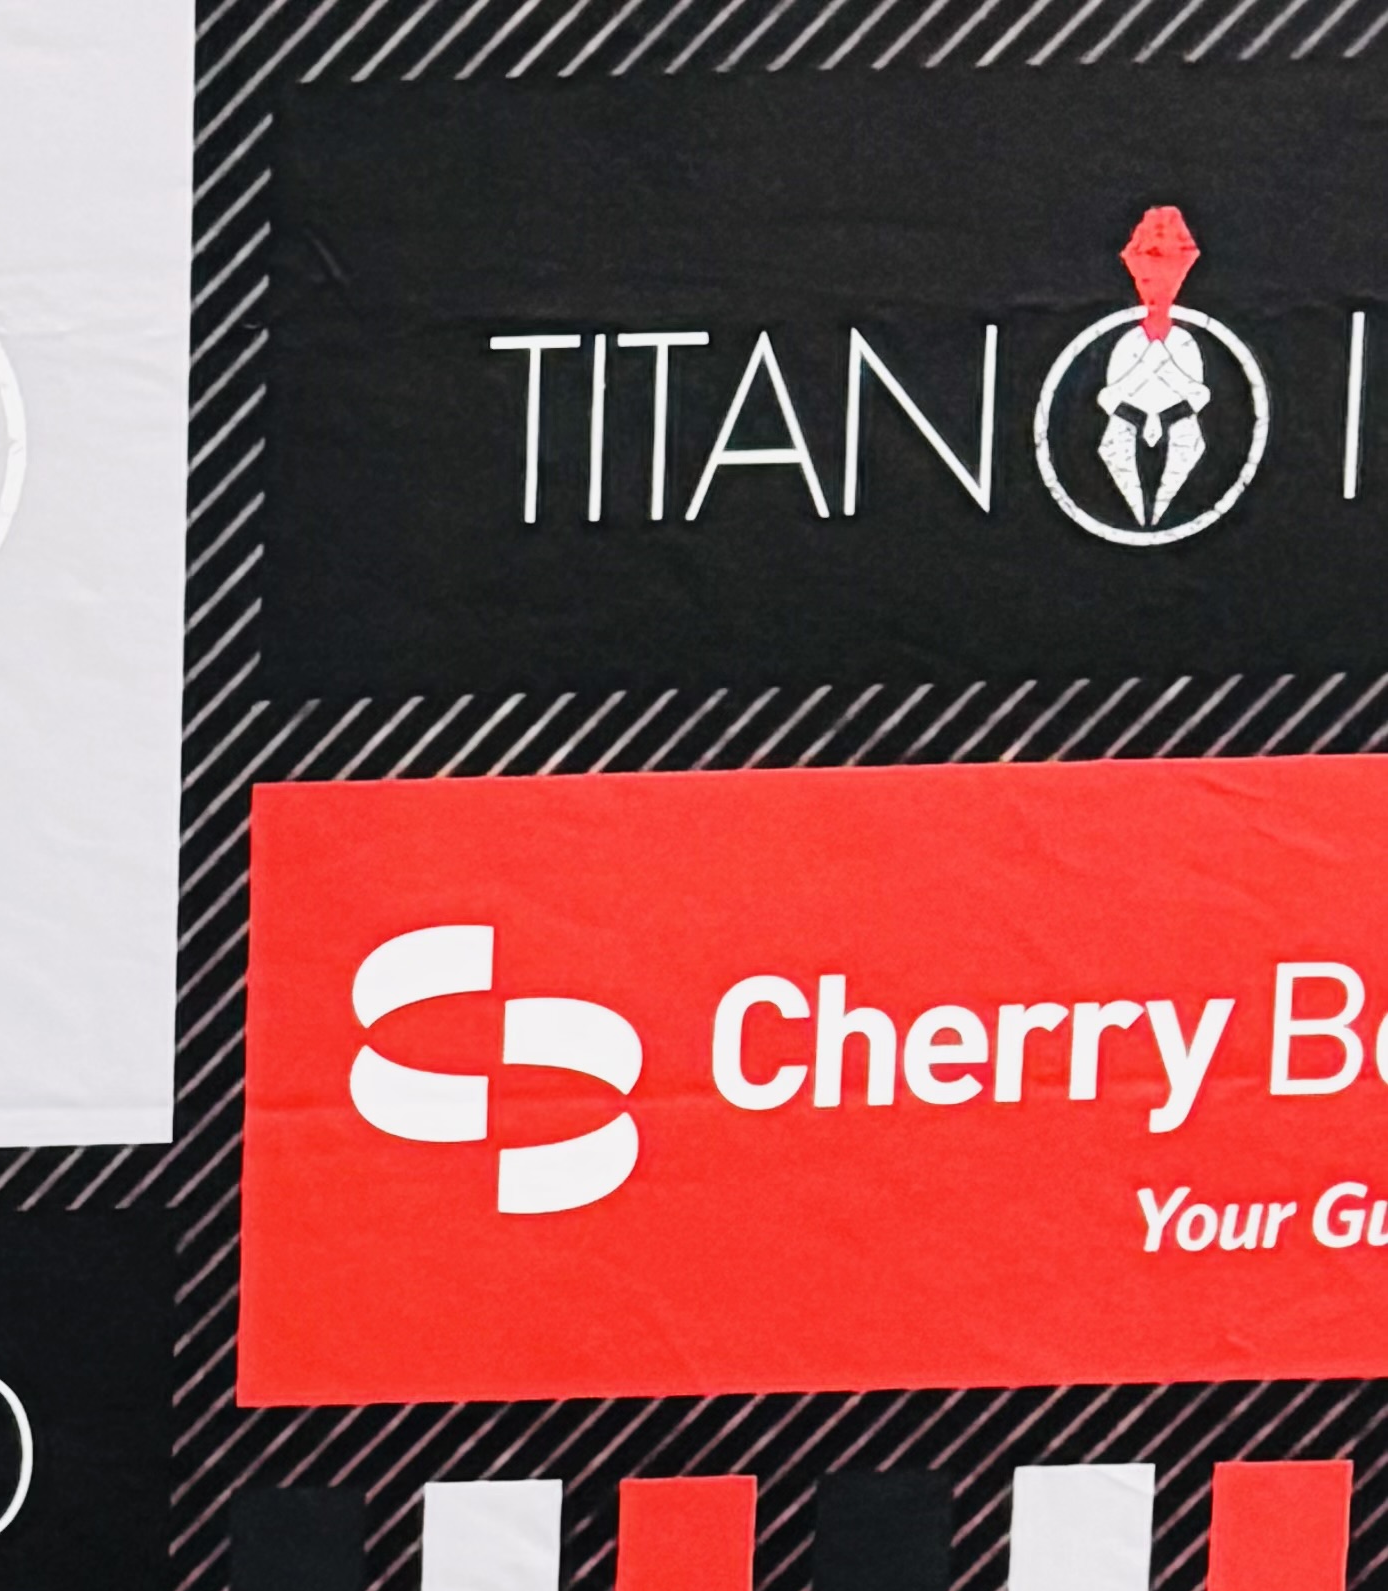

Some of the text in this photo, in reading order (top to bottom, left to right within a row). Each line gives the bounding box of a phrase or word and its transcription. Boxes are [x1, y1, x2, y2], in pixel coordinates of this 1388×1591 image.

[489, 324, 998, 524] TITAN
[711, 973, 1236, 1134] Cherry
[1136, 1185, 1298, 1253] Your
